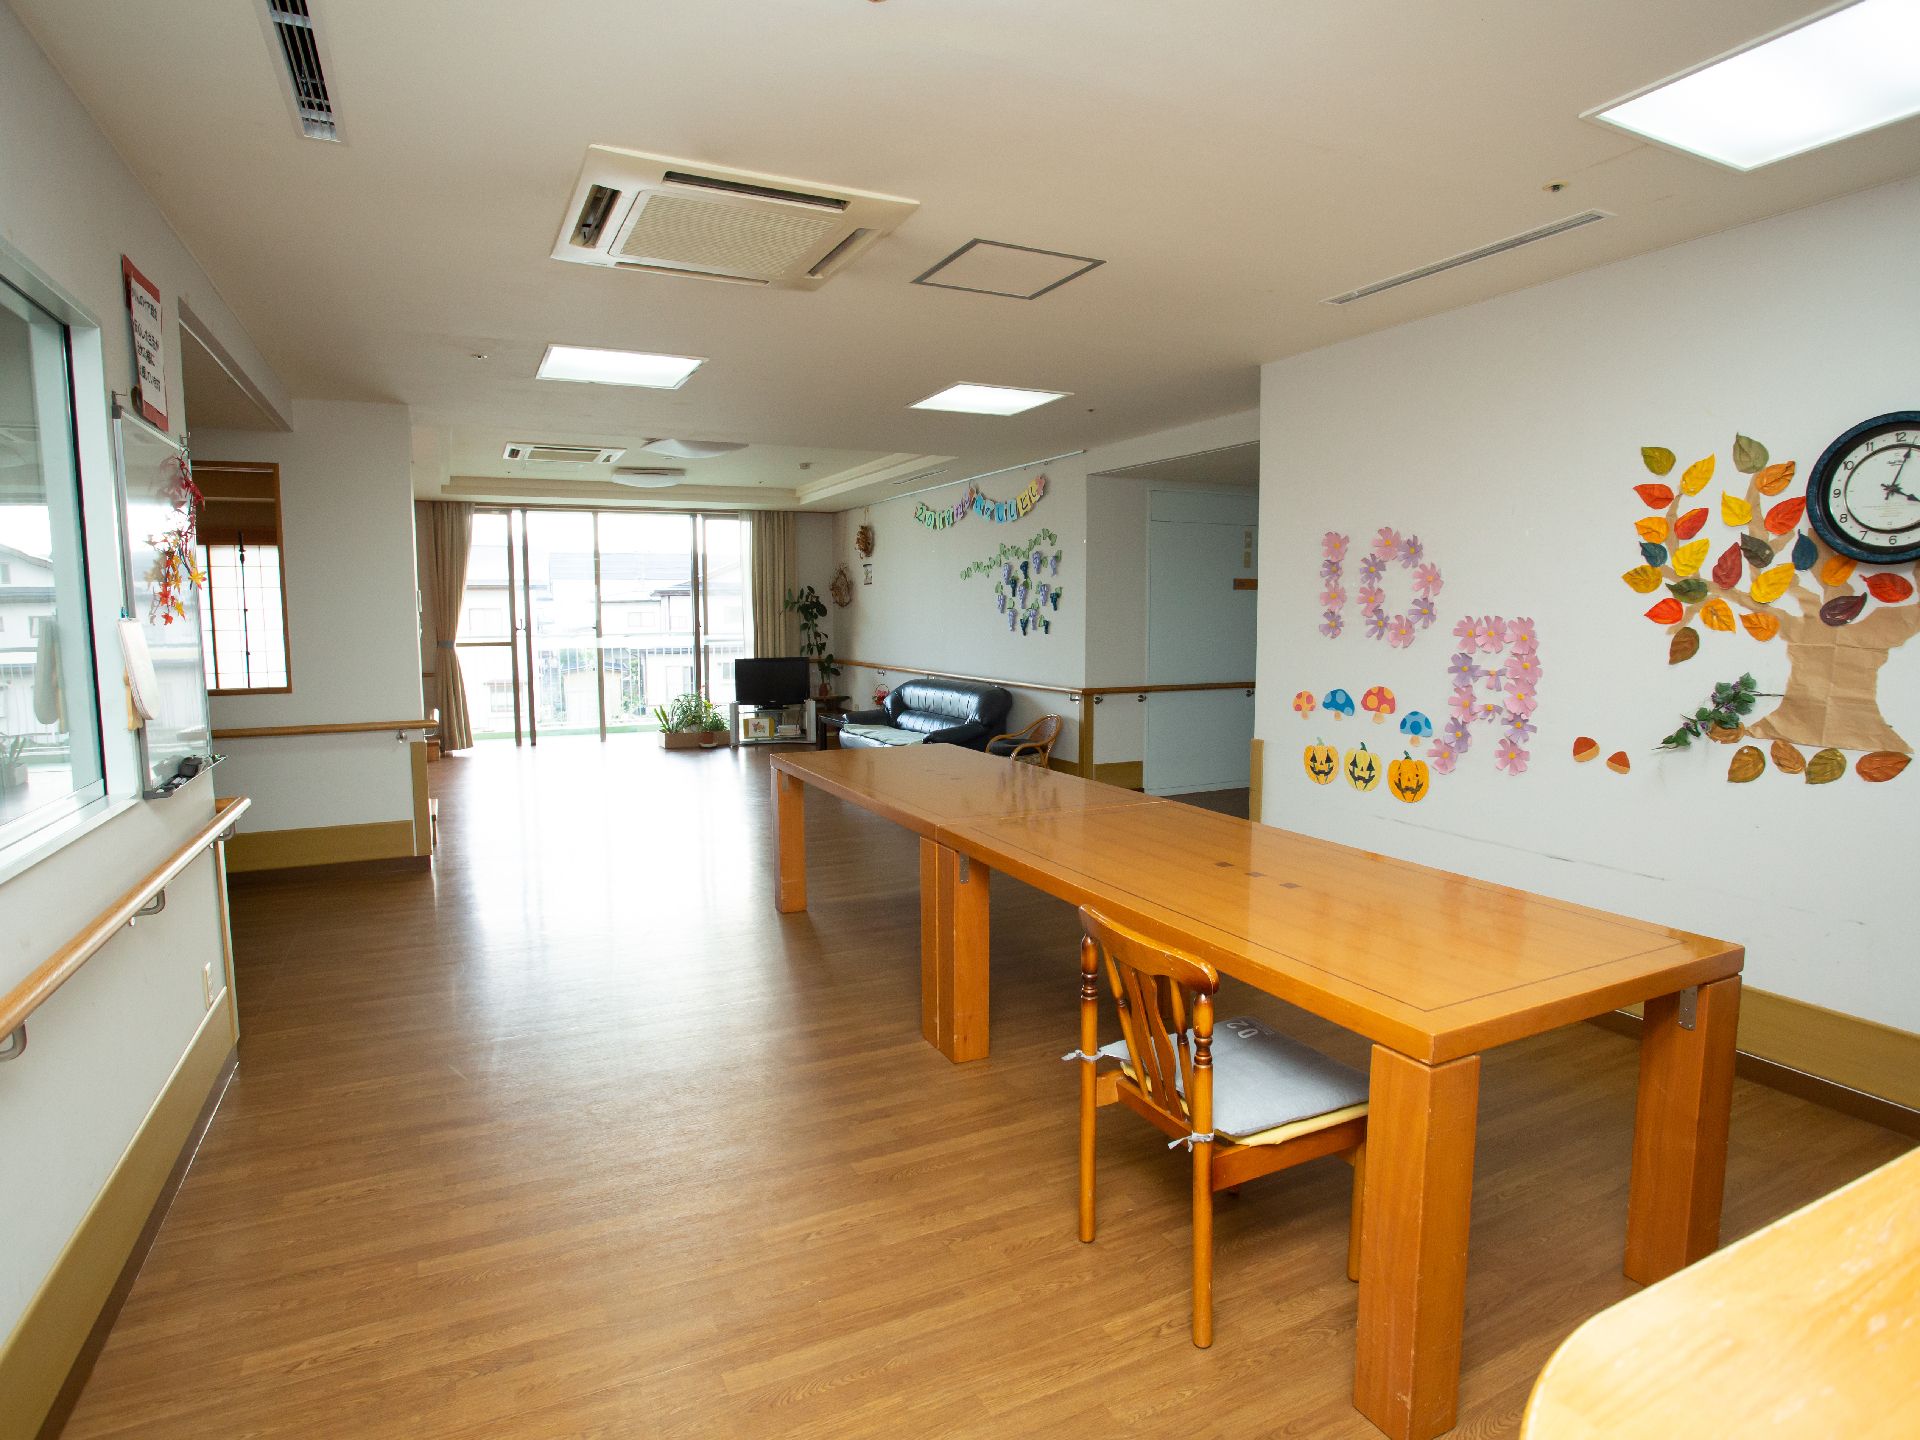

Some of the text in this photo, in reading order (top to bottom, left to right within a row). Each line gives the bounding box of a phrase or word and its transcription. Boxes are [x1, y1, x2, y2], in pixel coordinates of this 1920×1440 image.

[1896, 432, 1906, 442] 12
[1865, 441, 1875, 451] 11
[1843, 460, 1855, 471] 10
[1833, 488, 1841, 498] 9
[1839, 513, 1848, 523] 8
[1860, 530, 1868, 541] 7
[1888, 535, 1897, 545] 6
